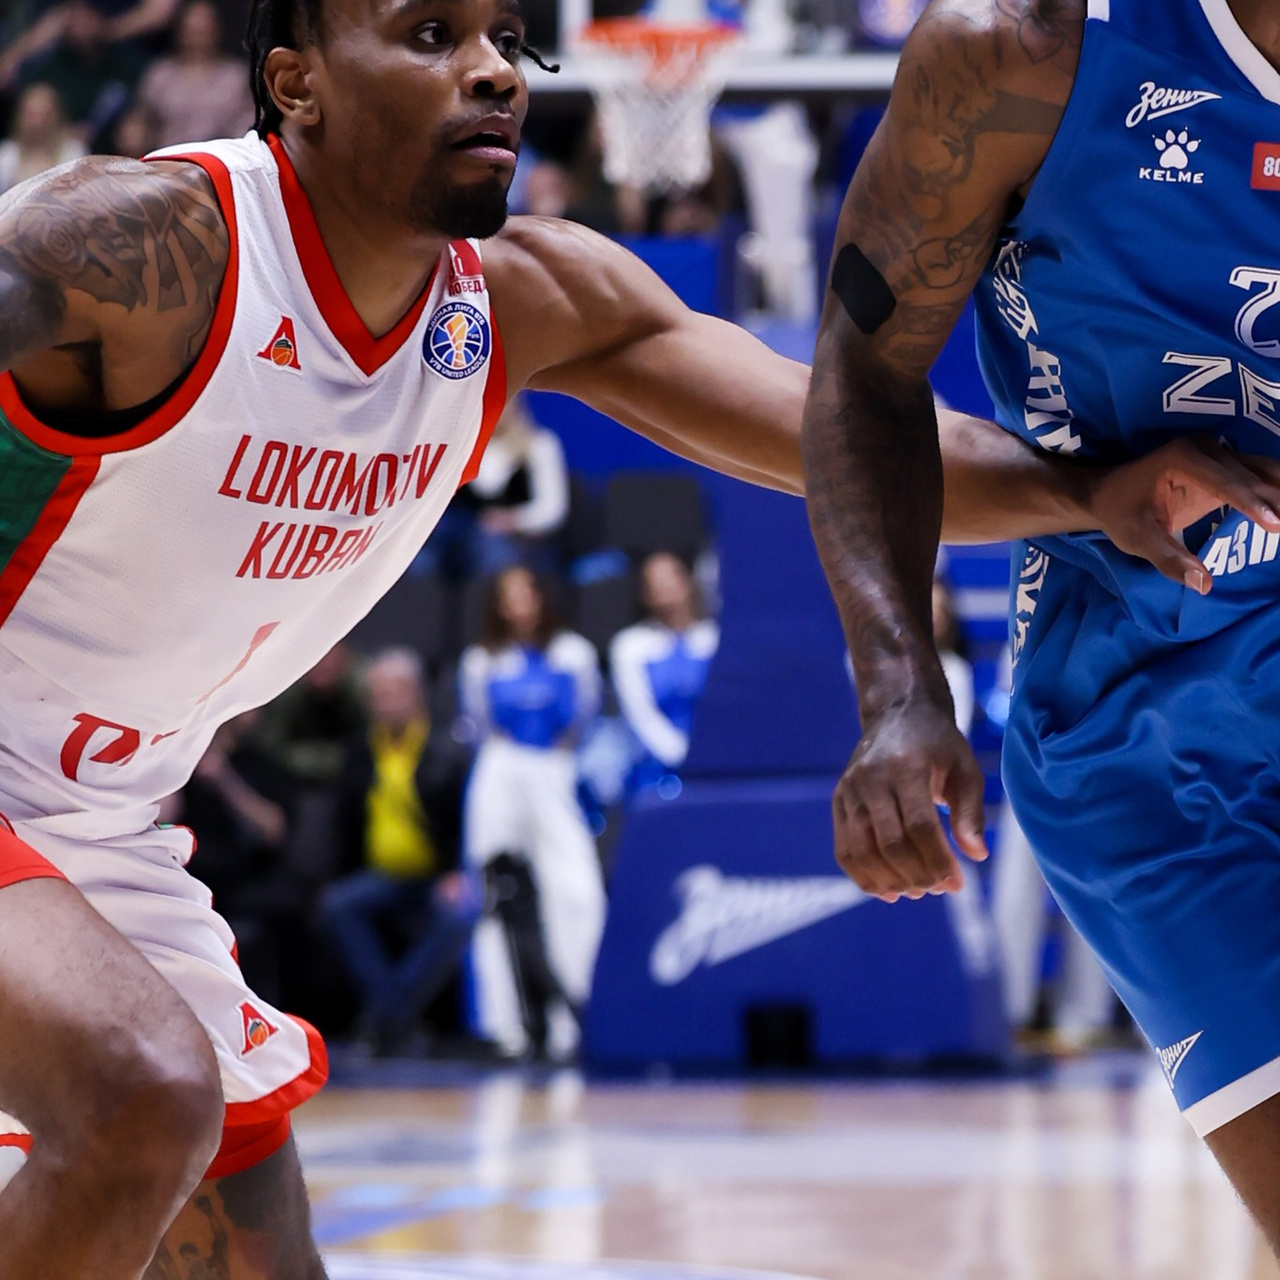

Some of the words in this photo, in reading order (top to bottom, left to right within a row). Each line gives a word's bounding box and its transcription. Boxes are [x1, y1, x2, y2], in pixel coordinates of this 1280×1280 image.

[1125, 81, 1223, 128] Зенит
[1139, 167, 1205, 184] KELME
[453, 303, 474, 315] ЛИГА
[441, 367, 463, 379] UNITED
[217, 435, 448, 517] LOKOMOTIV
